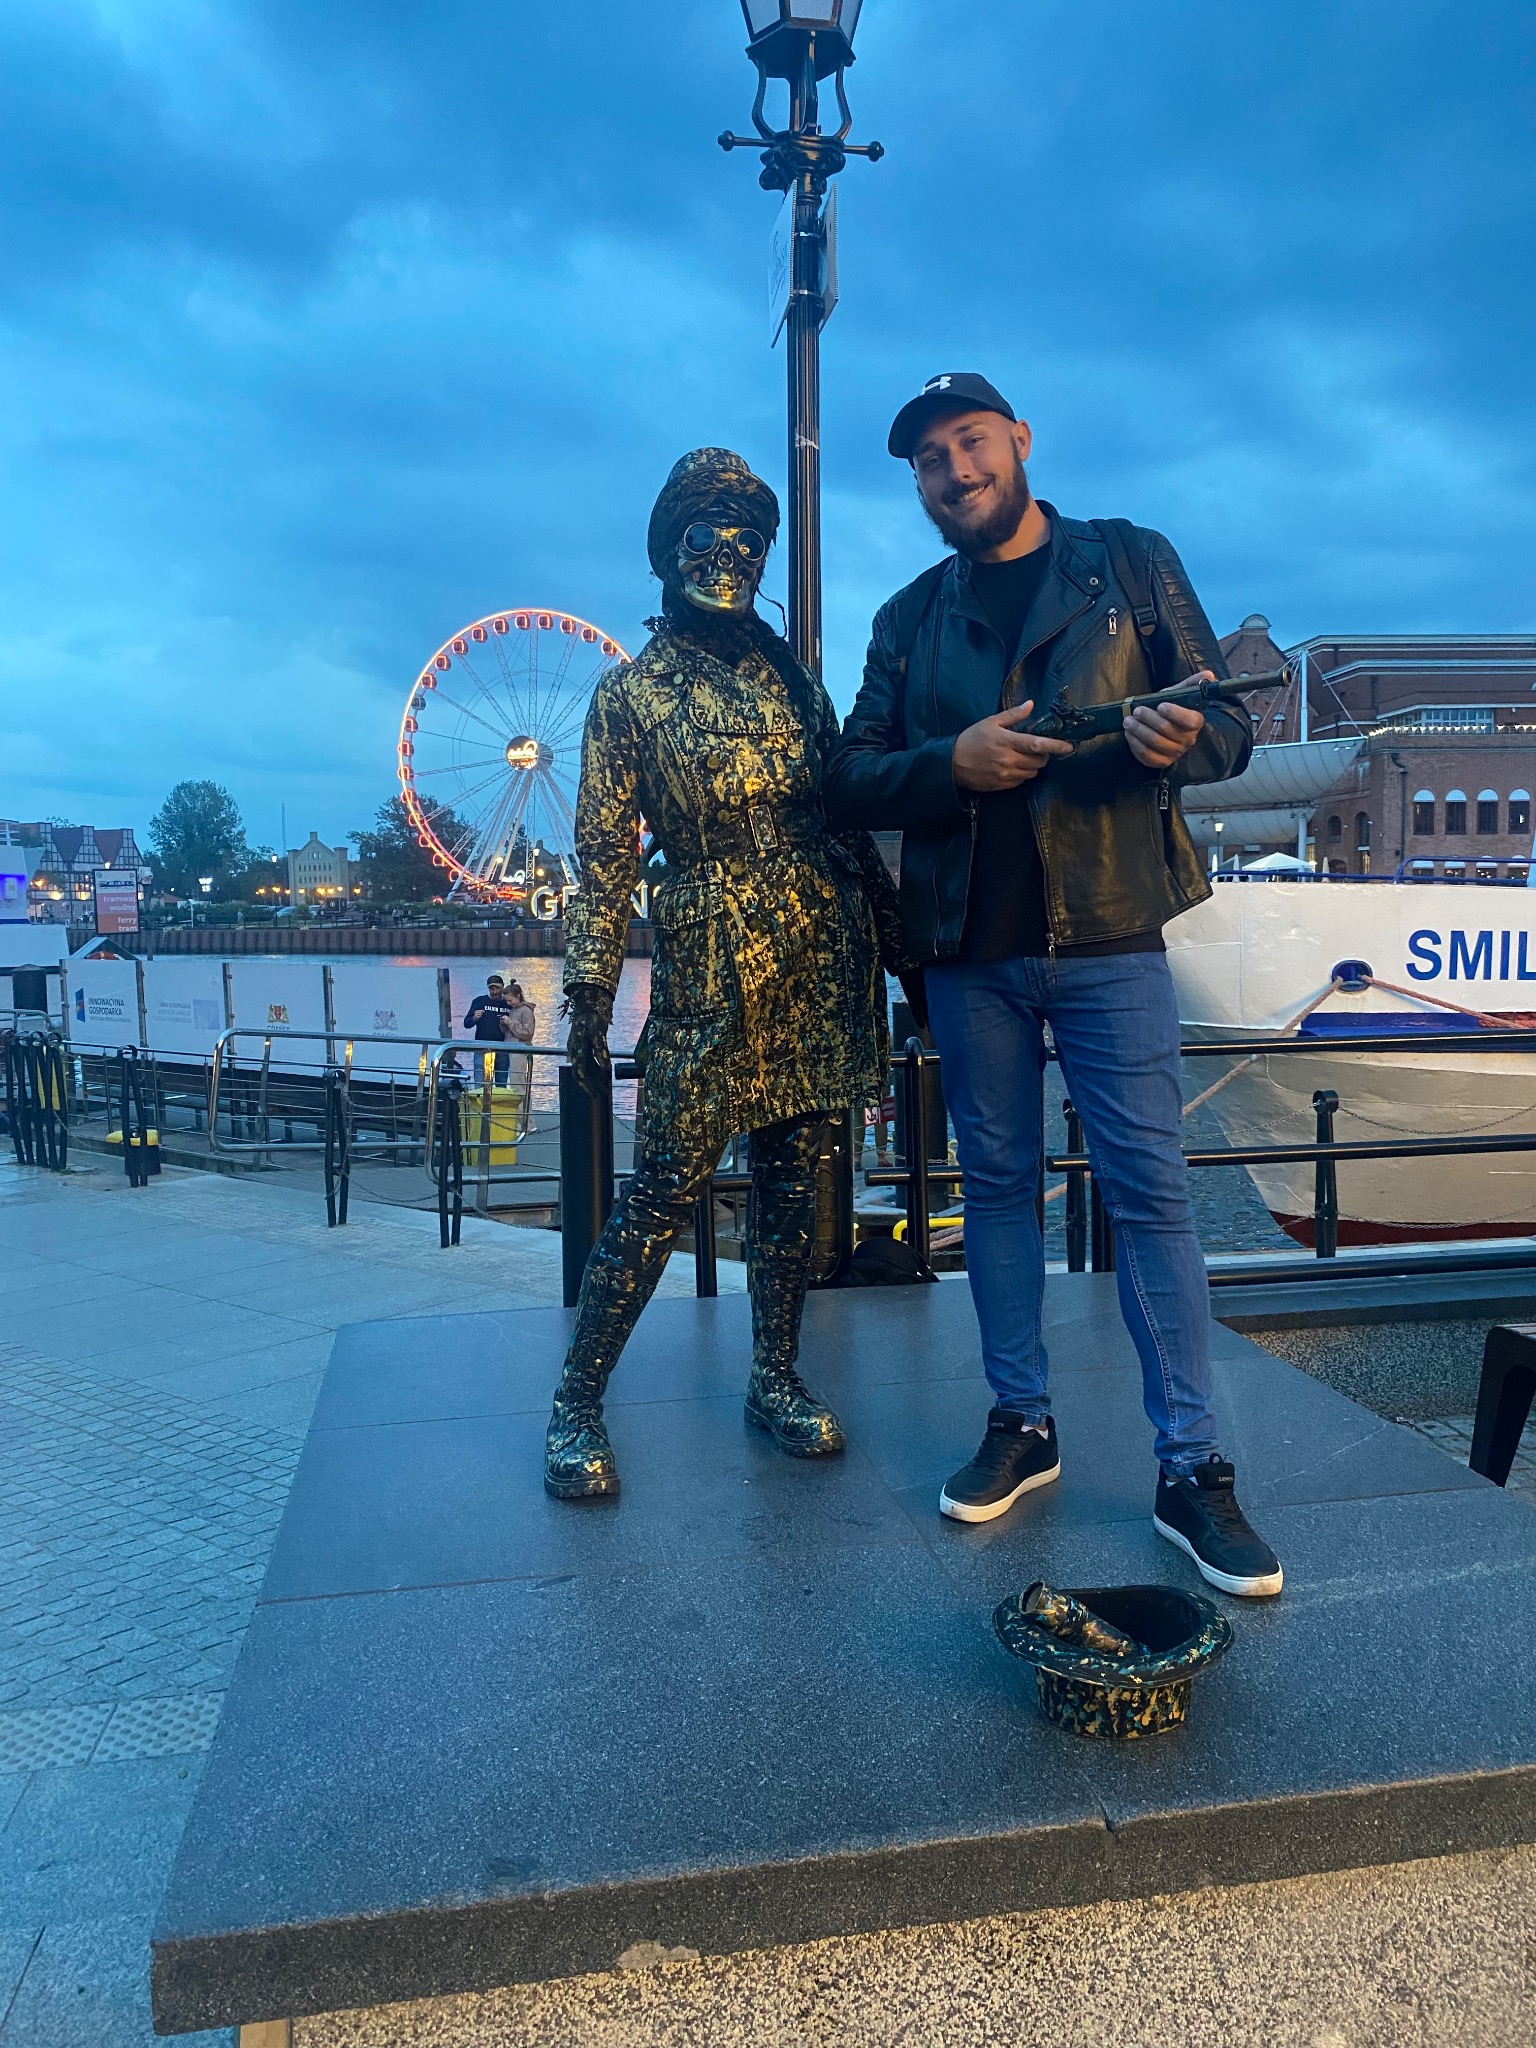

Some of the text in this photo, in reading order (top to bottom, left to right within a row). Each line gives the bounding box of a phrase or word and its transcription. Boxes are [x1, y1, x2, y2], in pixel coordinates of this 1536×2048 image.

[109, 904, 137, 912] wodny
[117, 916, 137, 924] ferry
[1405, 929, 1536, 981] SMIL
[88, 1006, 123, 1015] GOSPODARKA
